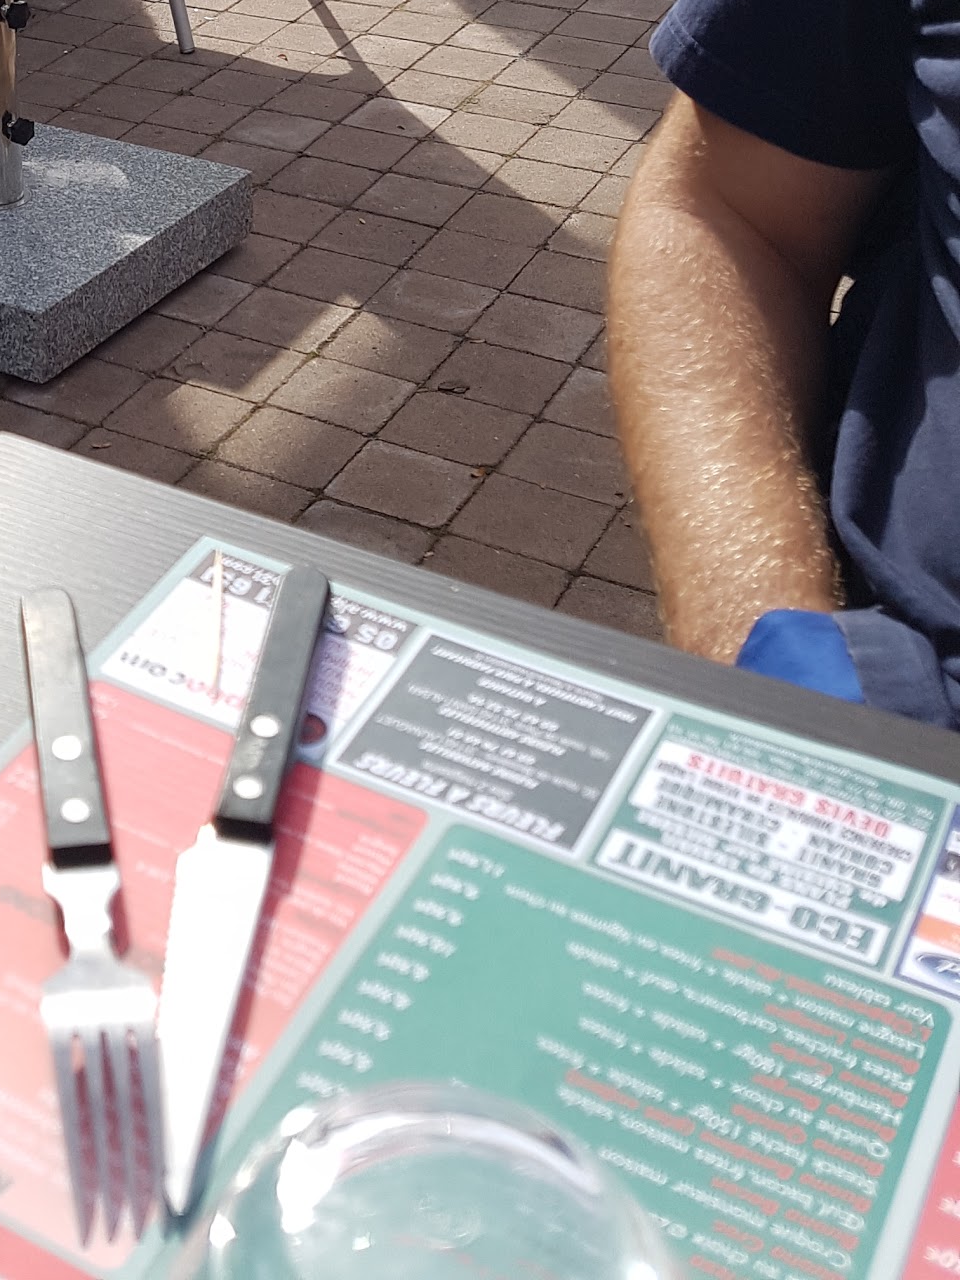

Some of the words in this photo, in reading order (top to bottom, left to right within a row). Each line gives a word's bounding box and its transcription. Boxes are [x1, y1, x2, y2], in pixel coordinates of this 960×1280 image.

[351, 619, 400, 653] 05
[353, 748, 448, 799] FLEURS
[685, 751, 806, 808] GRATUITS
[465, 790, 566, 842] FLEURS
[652, 793, 771, 847] SILESTONE
[813, 797, 891, 838] DEVIS
[796, 846, 883, 888] GRANIT
[806, 832, 895, 875] CORIAN
[606, 837, 876, 953] ECO-GRANIT
[821, 969, 892, 1011] tableau
[574, 1014, 629, 1050] frites
[647, 1007, 710, 1046] salade
[790, 992, 856, 1032] maison
[892, 998, 939, 1029] Voir
[531, 1032, 587, 1071] frites
[855, 1016, 928, 1060] Lasagne
[644, 1044, 709, 1083] salade
[859, 1058, 915, 1094] Pâtes
[553, 1083, 616, 1124] salade
[604, 1065, 666, 1104] salade
[727, 1079, 786, 1116] choix
[789, 1063, 905, 1126] Hamburger
[786, 1104, 814, 1126] au
[744, 1128, 808, 1167] haché
[814, 1115, 892, 1161] Quiche
[596, 1145, 668, 1188] maison
[690, 1144, 747, 1181] frites
[669, 1177, 766, 1233] monsieur
[766, 1220, 853, 1272] Croque
